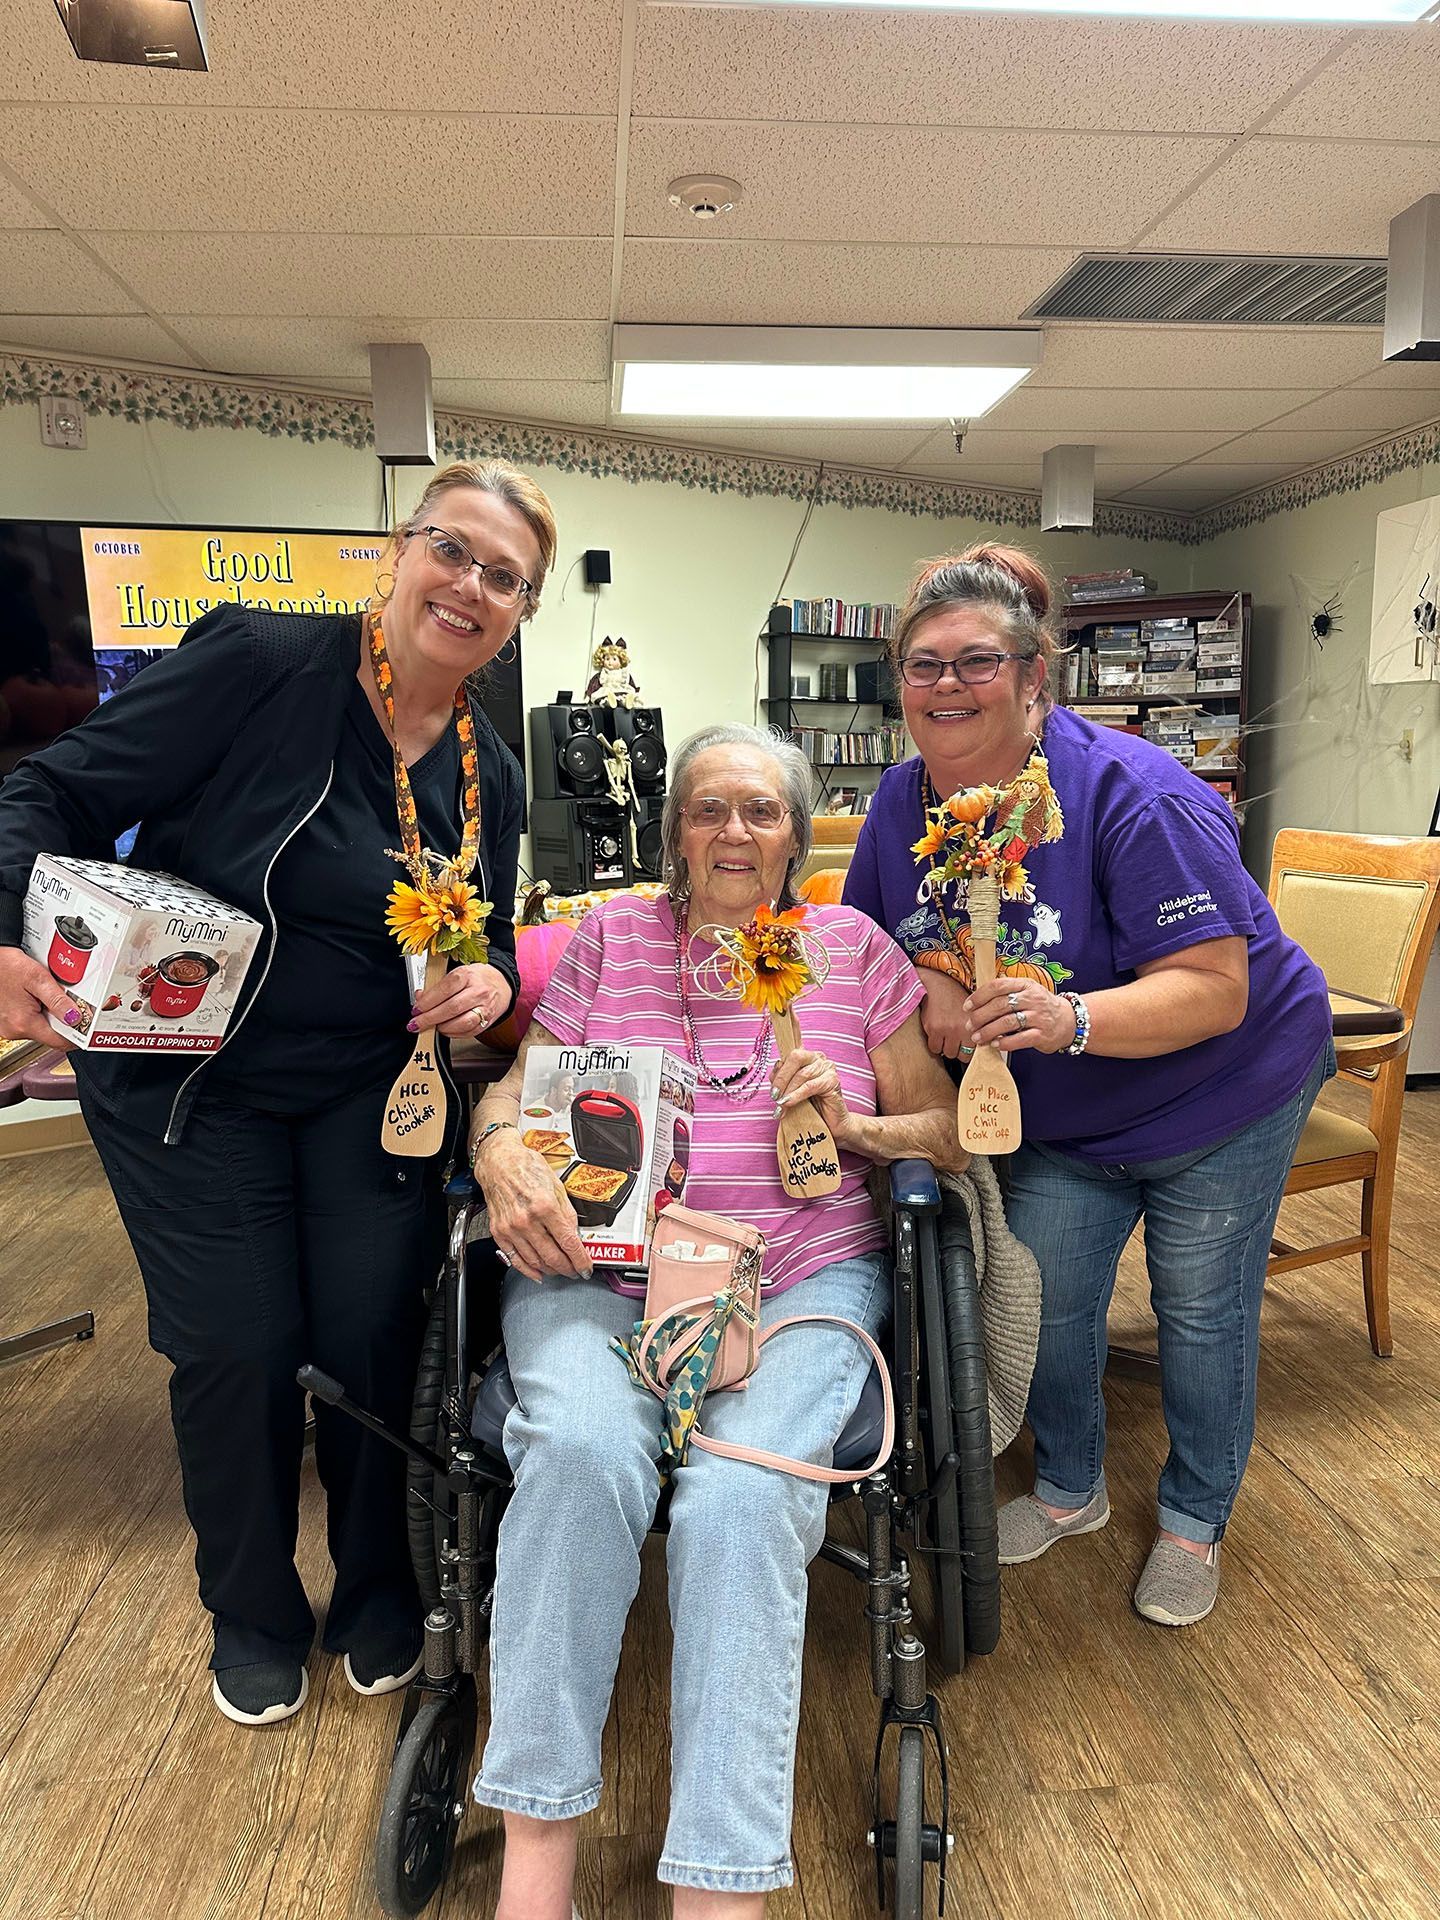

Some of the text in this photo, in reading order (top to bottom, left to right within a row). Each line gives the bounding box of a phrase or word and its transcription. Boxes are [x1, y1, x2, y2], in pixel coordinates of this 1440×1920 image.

[94, 542, 141, 555] OCTOBER
[339, 548, 381, 560] 25 CENTS
[201, 538, 294, 583] Good
[32, 869, 72, 901] MyMini
[1159, 889, 1212, 913] Hildebrand
[1157, 911, 1186, 926] Care
[165, 917, 228, 943] MyMini
[95, 1035, 156, 1046] CHOCOLATE
[156, 1037, 195, 1047] DIPPING
[195, 1039, 215, 1048] POT
[413, 1051, 435, 1071] #1
[558, 1050, 630, 1076] MyMini
[400, 1083, 430, 1098] HCC
[968, 1085, 1010, 1101] 3rd Place
[388, 1101, 418, 1124] Chili
[980, 1103, 998, 1113] HCC
[973, 1115, 997, 1127] Chili
[966, 1129, 988, 1140] Cook
[790, 1133, 805, 1156] 2nd
[788, 1151, 813, 1170] HCC
[586, 1246, 626, 1259] MAKER
